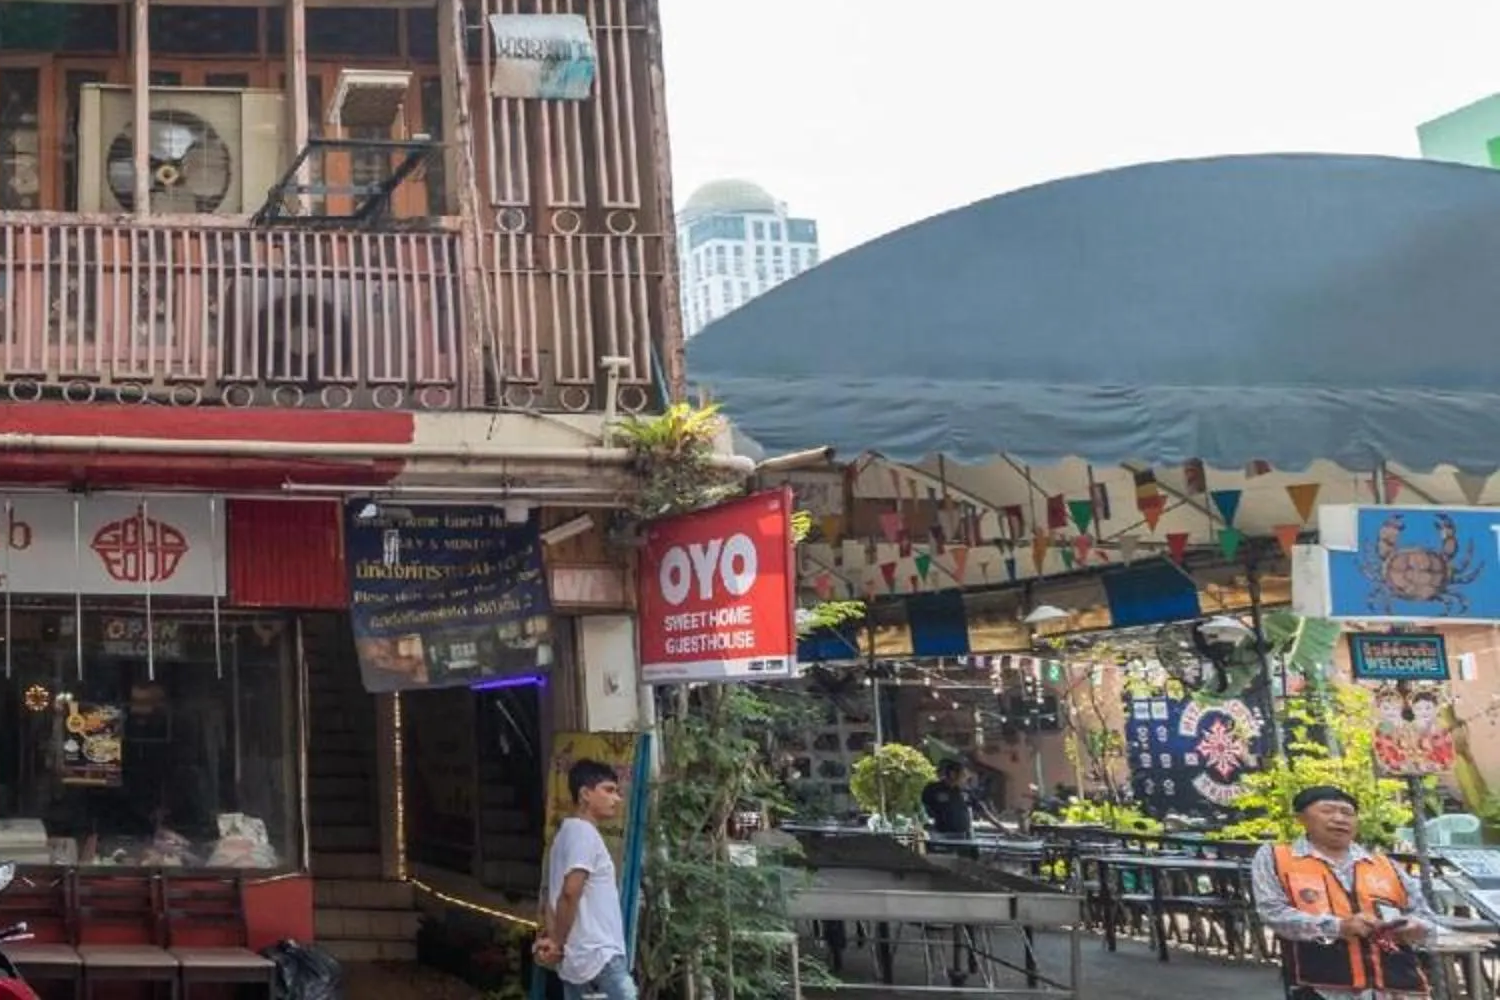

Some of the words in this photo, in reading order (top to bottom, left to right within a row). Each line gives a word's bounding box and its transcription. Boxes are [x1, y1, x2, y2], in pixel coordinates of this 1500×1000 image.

[659, 532, 758, 606] OYO
[664, 611, 708, 632] SWEET
[709, 605, 753, 628] HOME
[664, 630, 755, 655] GUESTHOUSE
